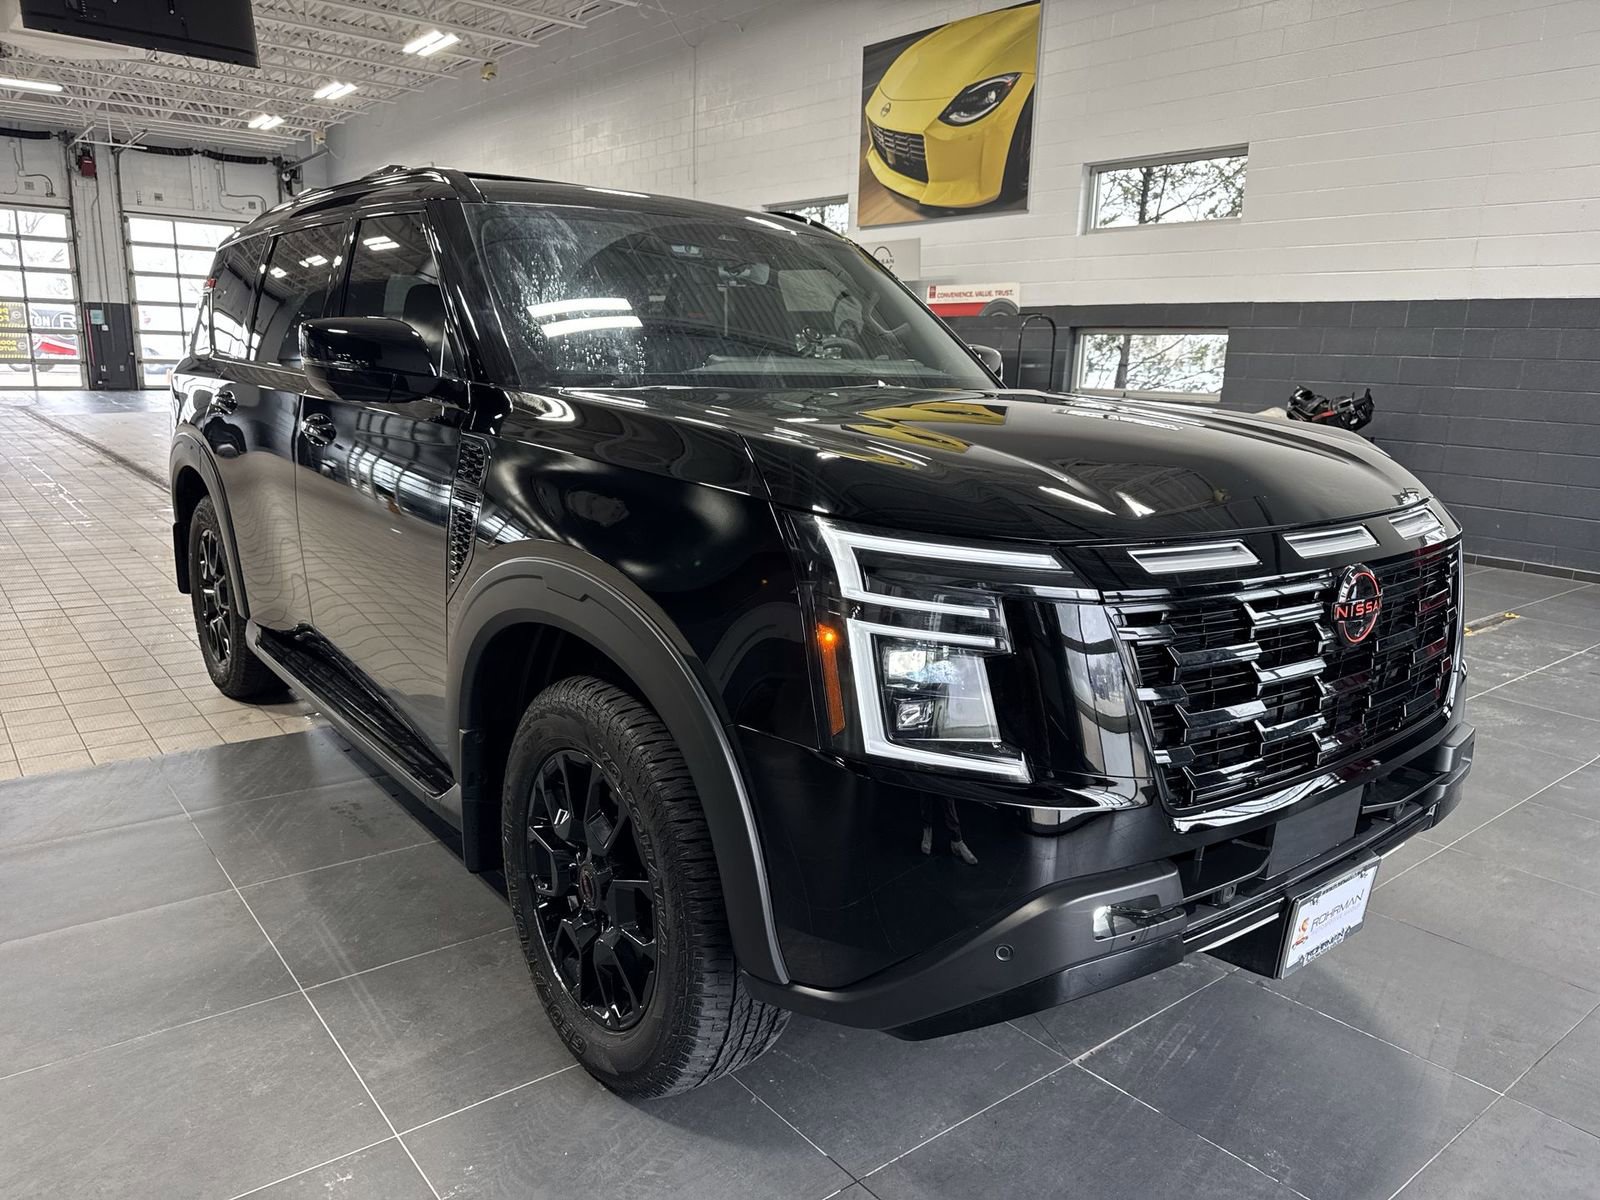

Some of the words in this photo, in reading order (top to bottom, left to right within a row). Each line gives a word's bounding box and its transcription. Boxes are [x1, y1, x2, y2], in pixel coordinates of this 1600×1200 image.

[937, 291, 974, 299] CONVENIENCE.
[994, 289, 1014, 297] TRUST.
[1310, 888, 1365, 932] ROHRMAN
